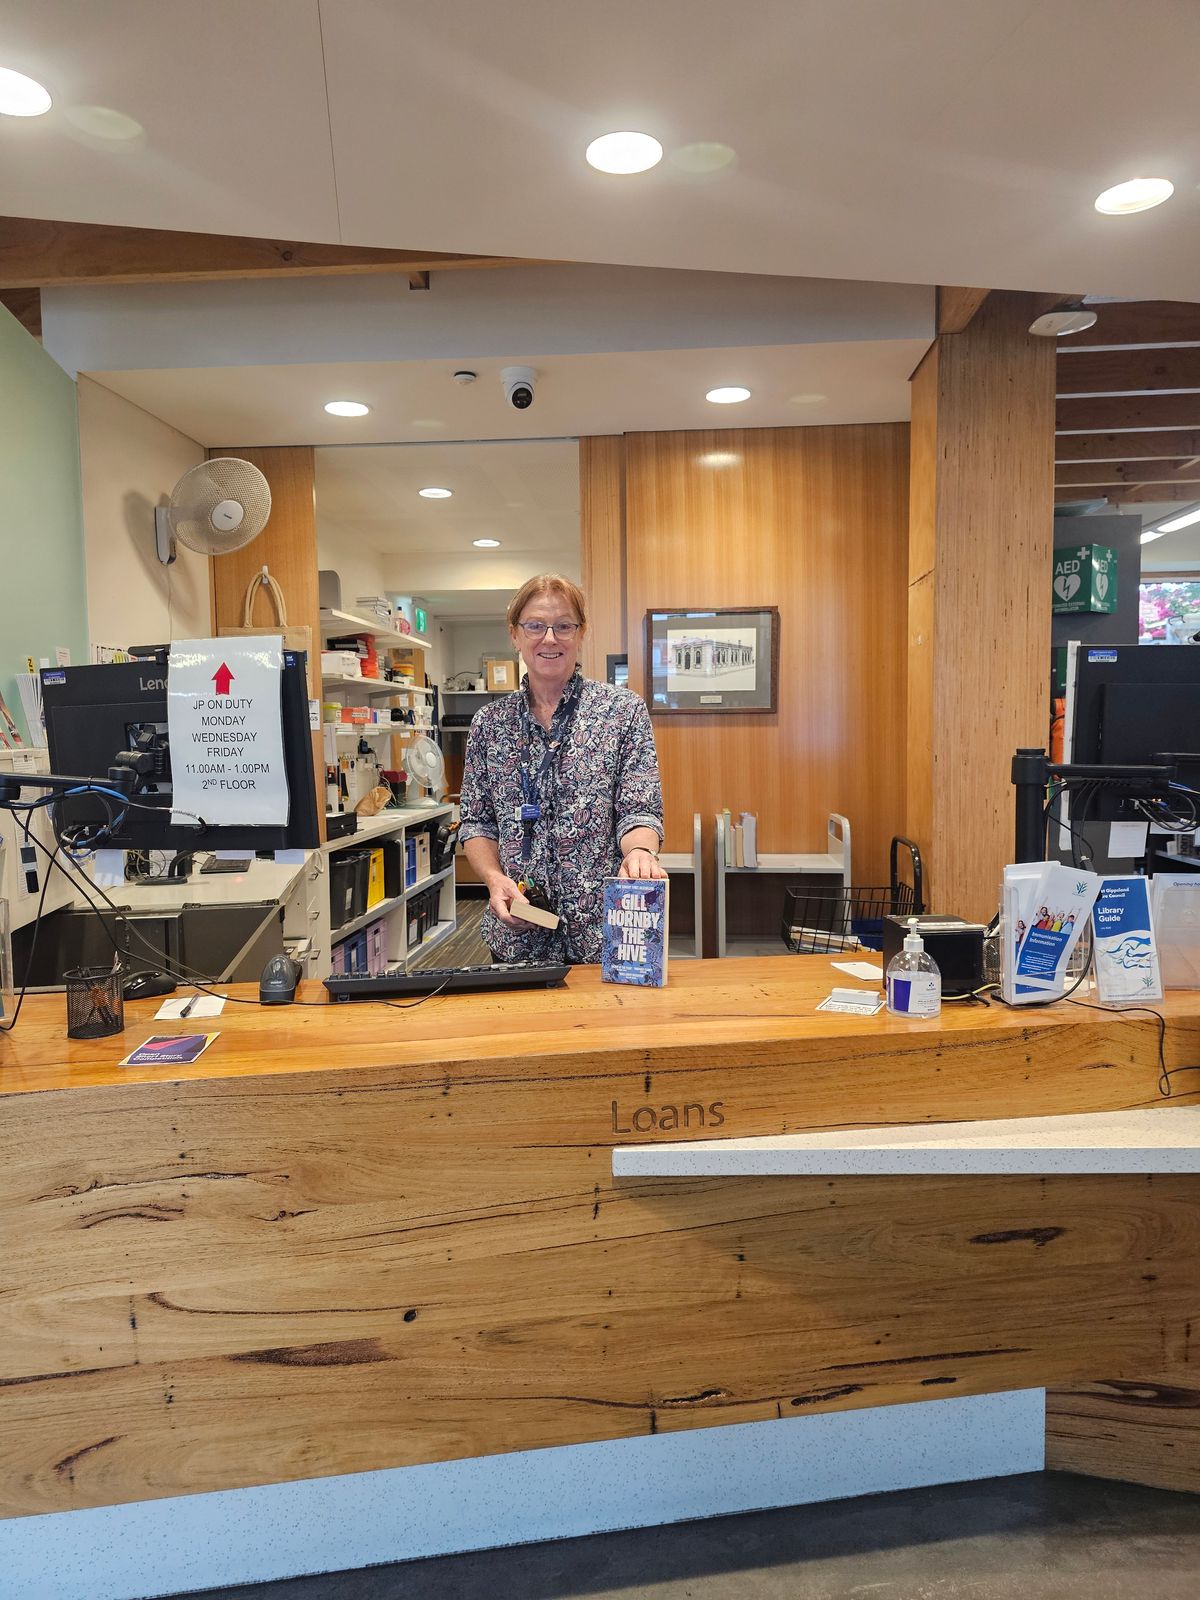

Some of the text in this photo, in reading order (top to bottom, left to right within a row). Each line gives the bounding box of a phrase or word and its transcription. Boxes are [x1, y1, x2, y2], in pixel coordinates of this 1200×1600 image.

[1055, 560, 1080, 575] AED
[193, 699, 253, 710] JP ON DUTY
[201, 716, 246, 726] MONDAY
[192, 732, 257, 742] WEDNESDAY
[207, 747, 244, 757] FRIDAY
[186, 764, 225, 774] 11.00AM
[234, 764, 270, 773] 1.00PM
[202, 779, 257, 790] 2ND FLOOR
[621, 894, 647, 911] GILL
[607, 909, 660, 929] HORNBY
[621, 926, 645, 945] THE
[617, 944, 647, 963] HIVE
[611, 1100, 725, 1134] Loans
